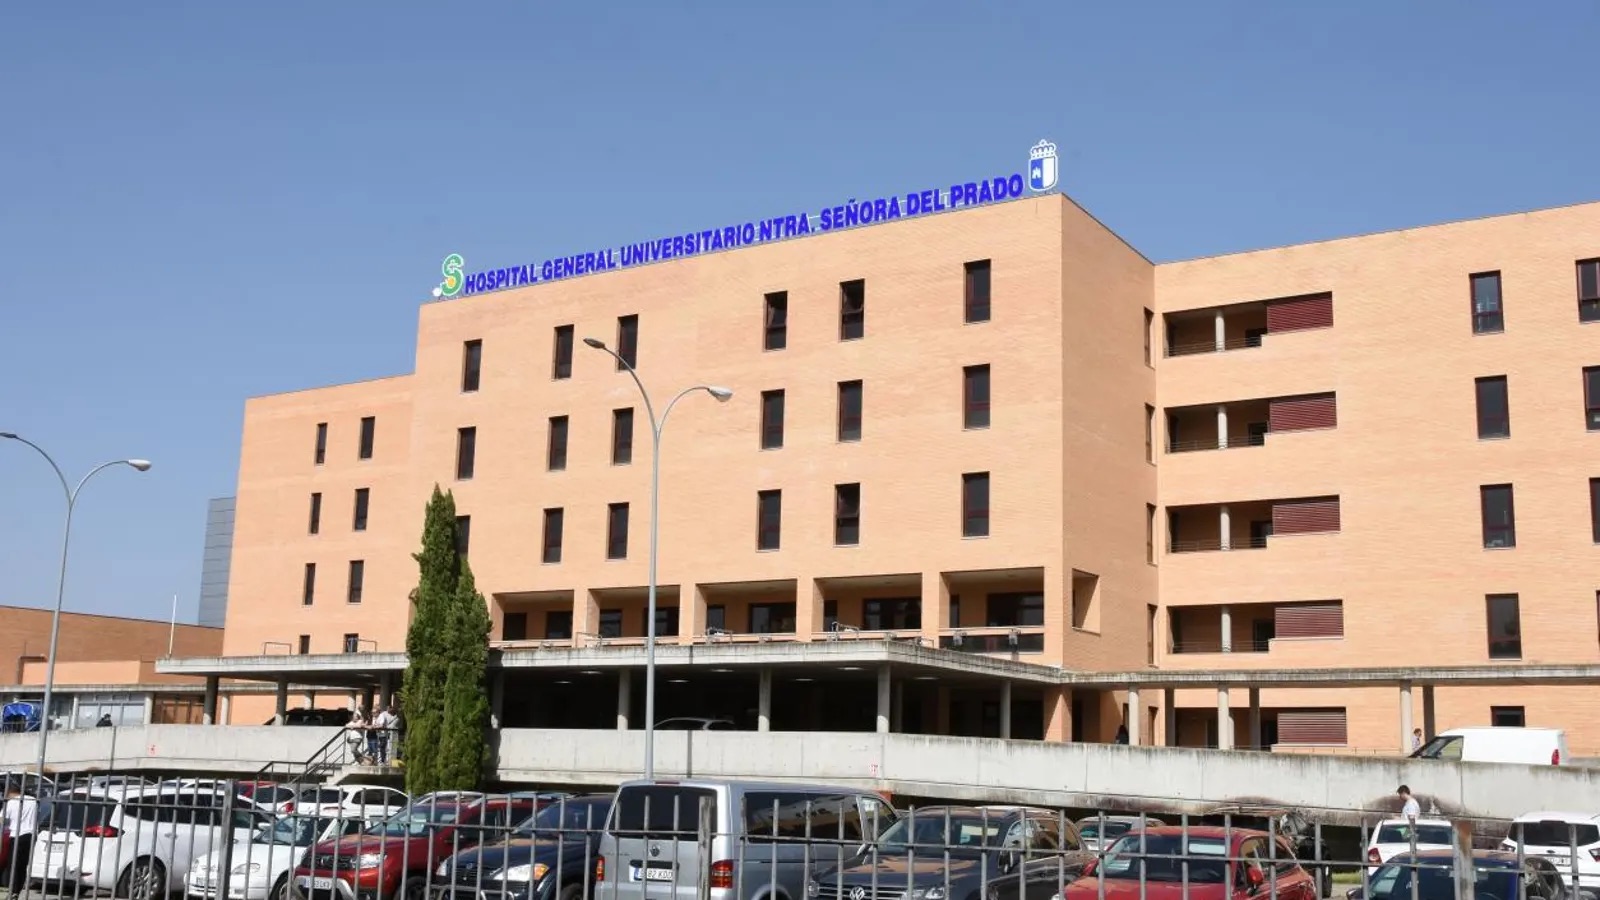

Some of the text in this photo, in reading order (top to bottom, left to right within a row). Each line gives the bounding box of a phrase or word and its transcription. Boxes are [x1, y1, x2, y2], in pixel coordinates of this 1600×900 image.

[465, 173, 1024, 293] HOSPITAL GENERAL UNIVERSITARIO NTRA. SEÑORA DEL PRADO
